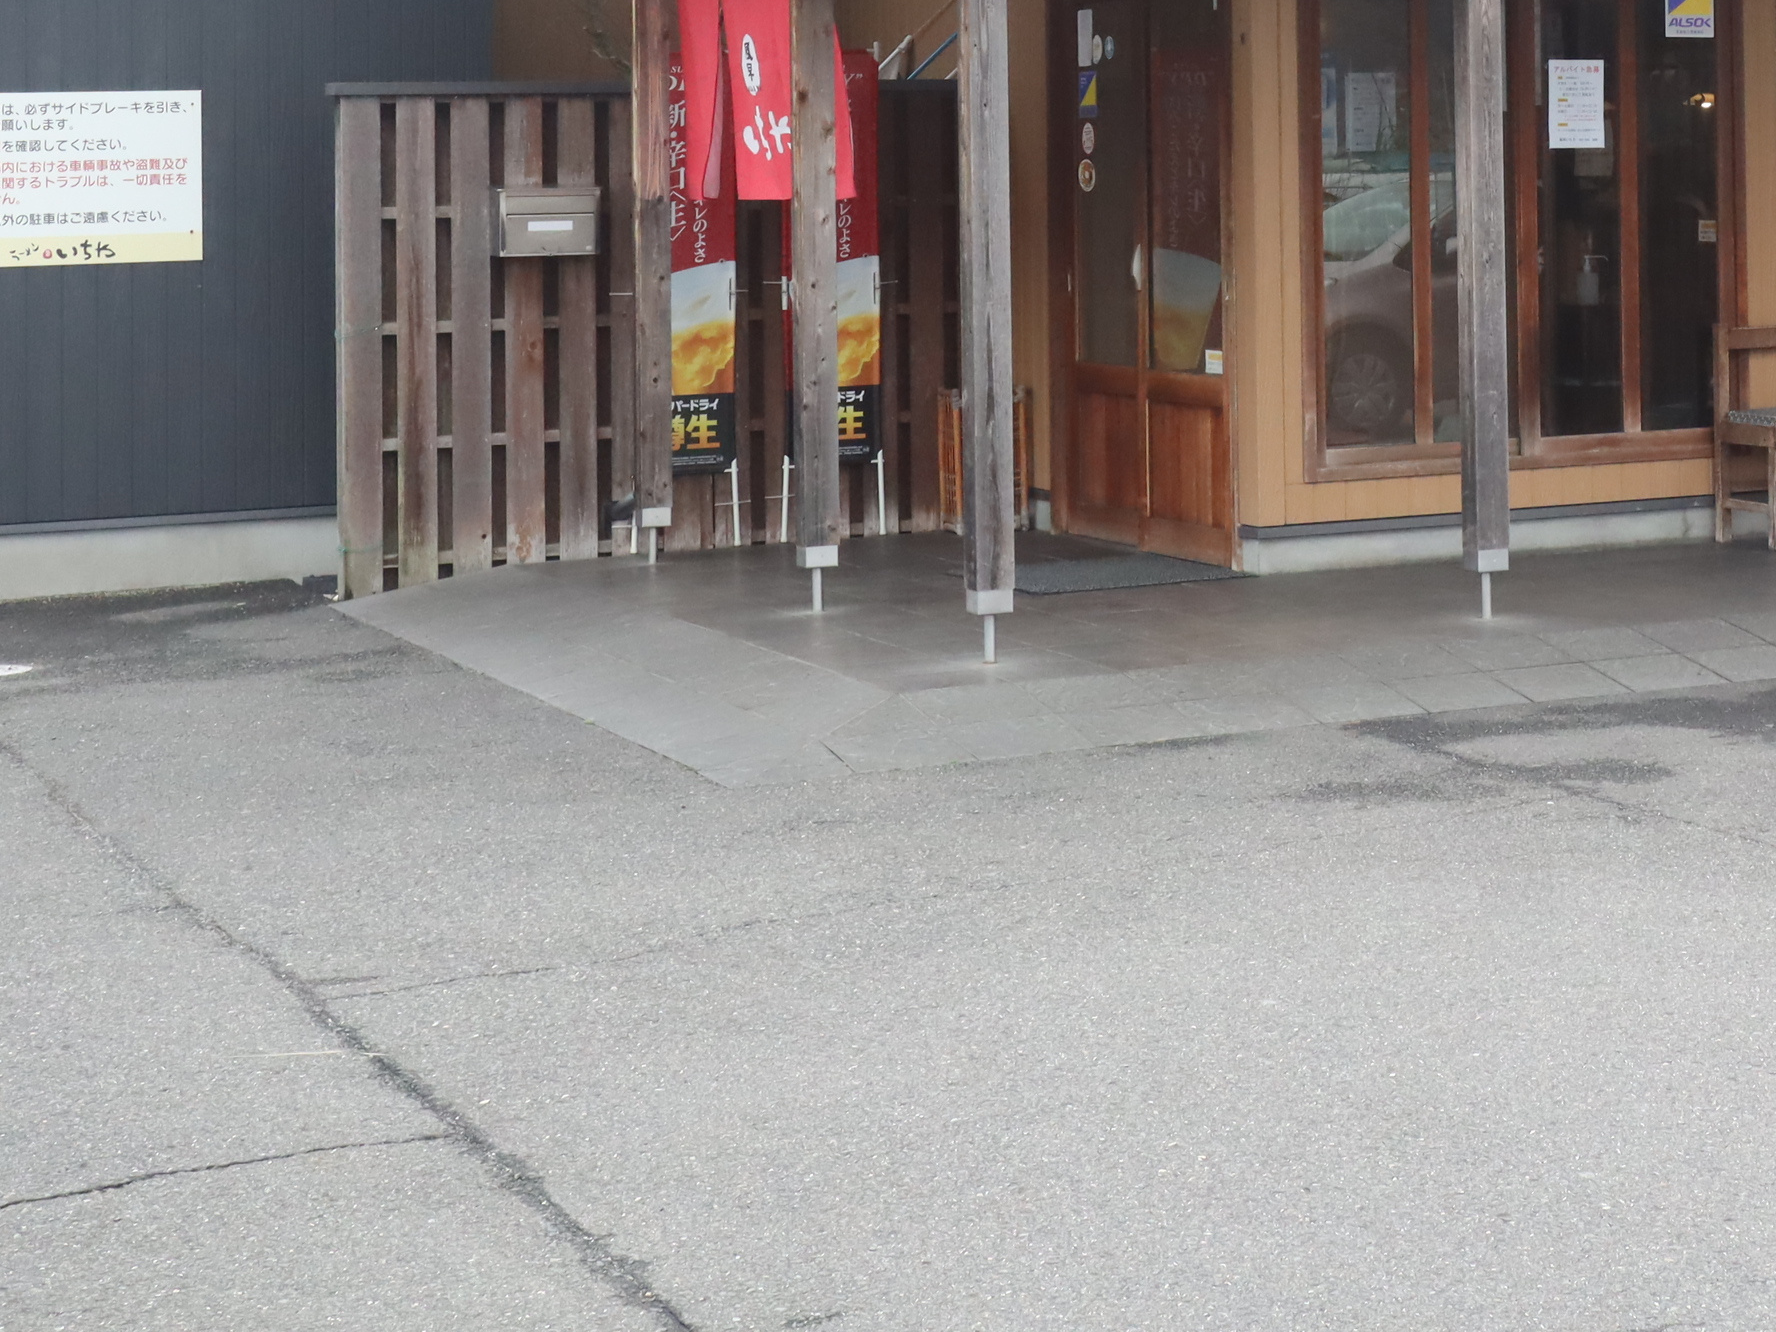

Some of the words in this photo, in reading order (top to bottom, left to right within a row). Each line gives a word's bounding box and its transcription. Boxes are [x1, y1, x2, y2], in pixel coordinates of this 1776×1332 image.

[1669, 17, 1712, 28] ALSOK
[1, 100, 188, 116] は、必ずサイドブレーキを引き、
[1, 118, 74, 132] 願いします。
[2, 138, 128, 153] を確認してください。
[1, 173, 188, 189] 関するトラブルは、一切責任を
[0, 210, 169, 226] 外の駐車はご遠慮ください。
[56, 239, 116, 261] いちや
